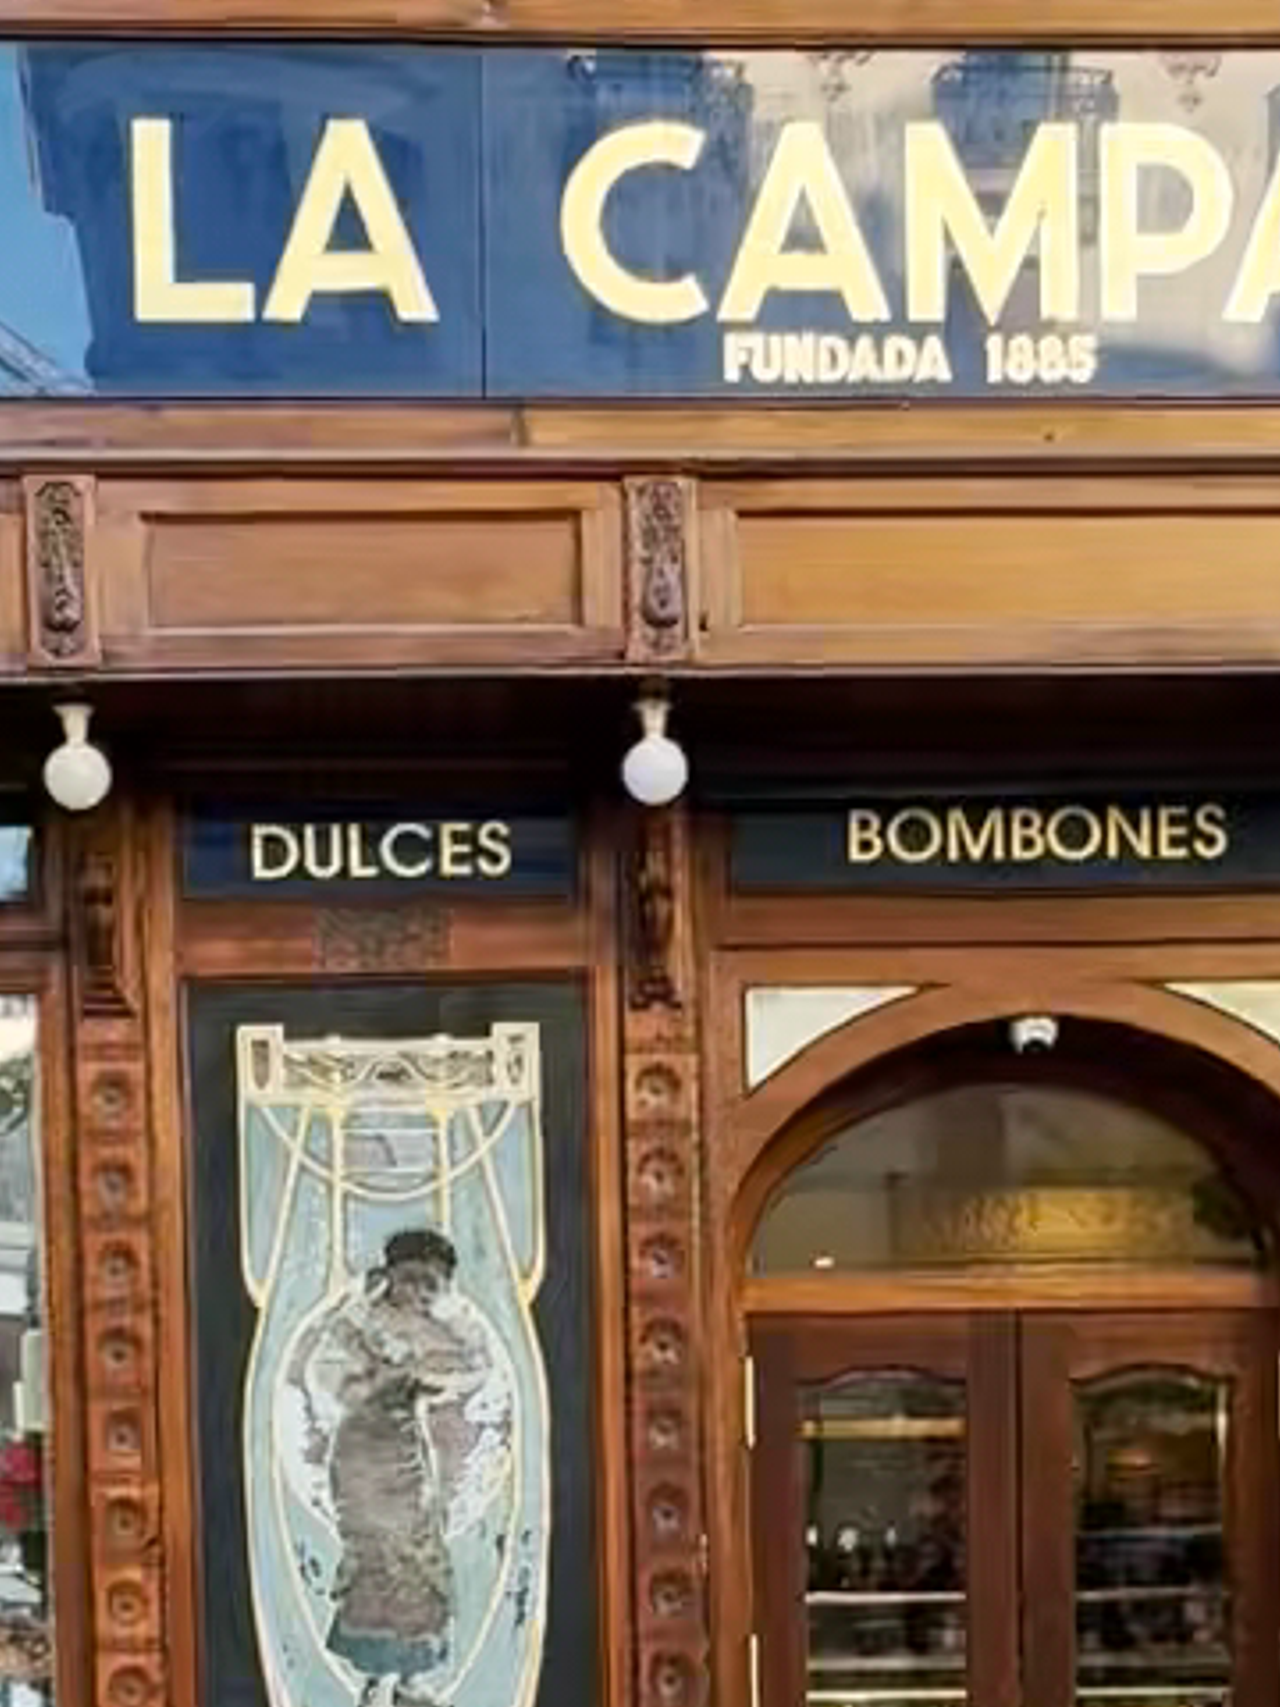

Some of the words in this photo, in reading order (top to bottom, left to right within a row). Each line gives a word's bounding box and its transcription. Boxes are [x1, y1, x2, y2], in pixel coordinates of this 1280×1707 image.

[130, 117, 440, 325] LA
[722, 332, 952, 384] FUNDADA
[985, 332, 1098, 384] 1885
[251, 820, 512, 881] DULCES
[846, 805, 1229, 864] BOMBONES
